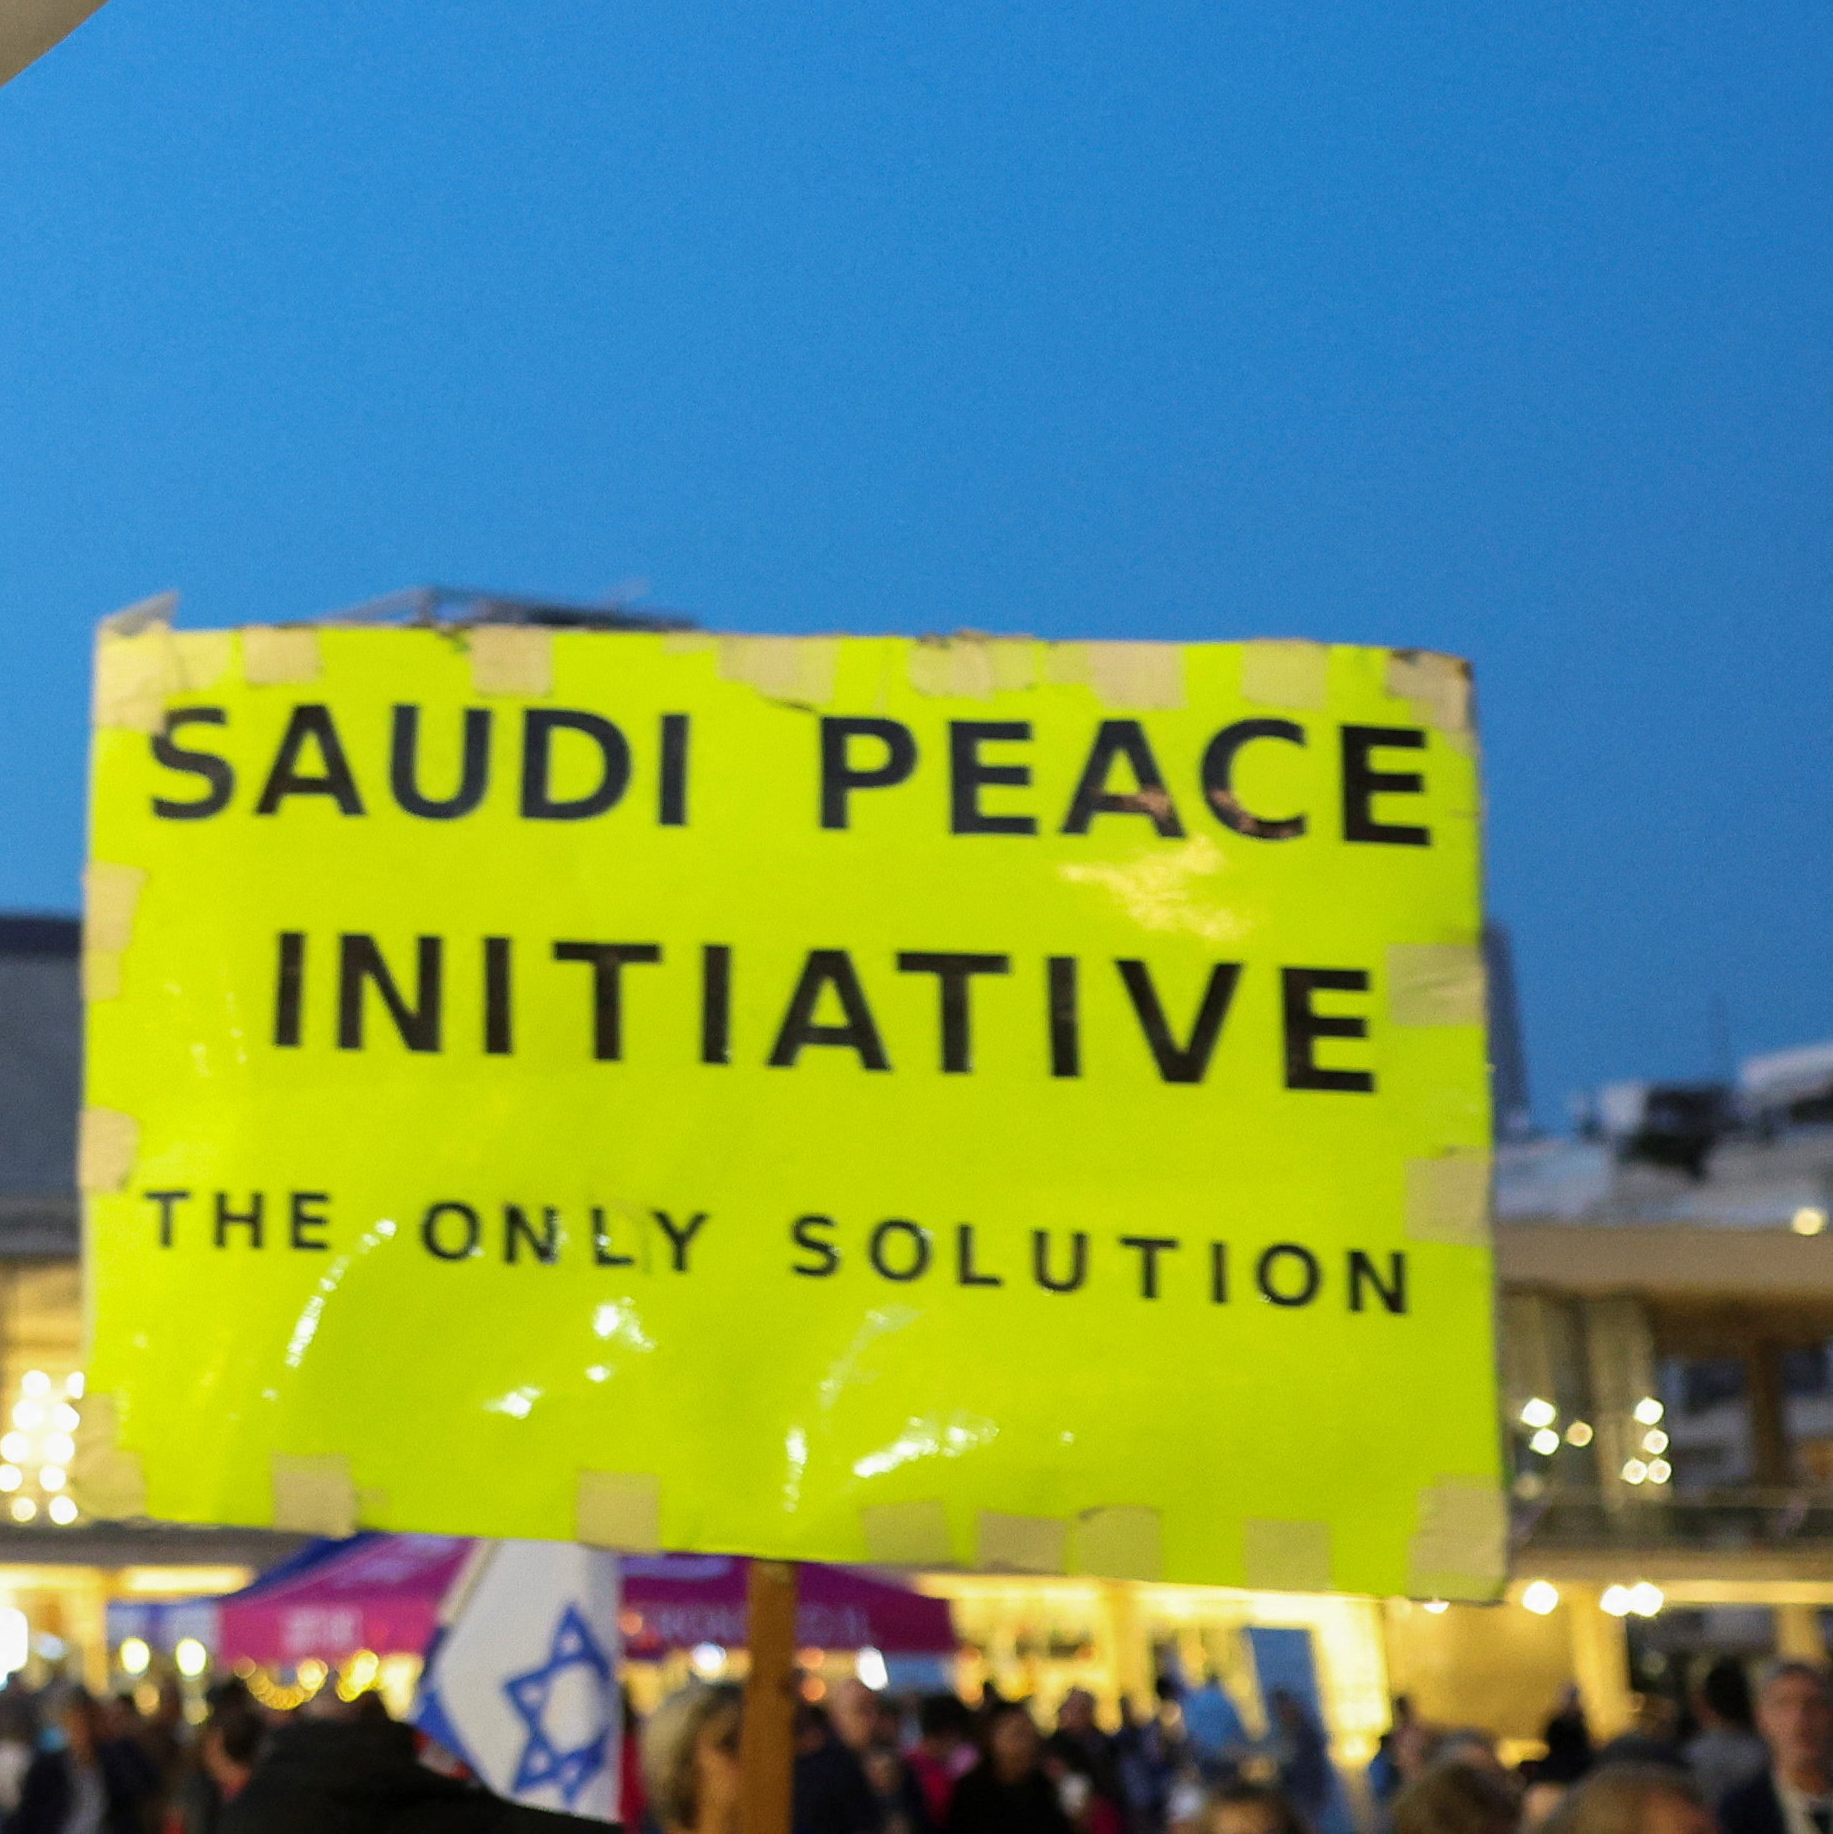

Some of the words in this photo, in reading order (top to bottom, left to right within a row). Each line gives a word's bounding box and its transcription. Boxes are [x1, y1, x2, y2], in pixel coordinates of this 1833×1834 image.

[148, 702, 692, 828] SAUDI
[815, 714, 1435, 850] PEACE
[271, 929, 1379, 1096] INITIATIVE
[142, 1188, 336, 1253] THE
[417, 1198, 711, 1275] ONLY
[789, 1213, 1412, 1318] SOLUTION
